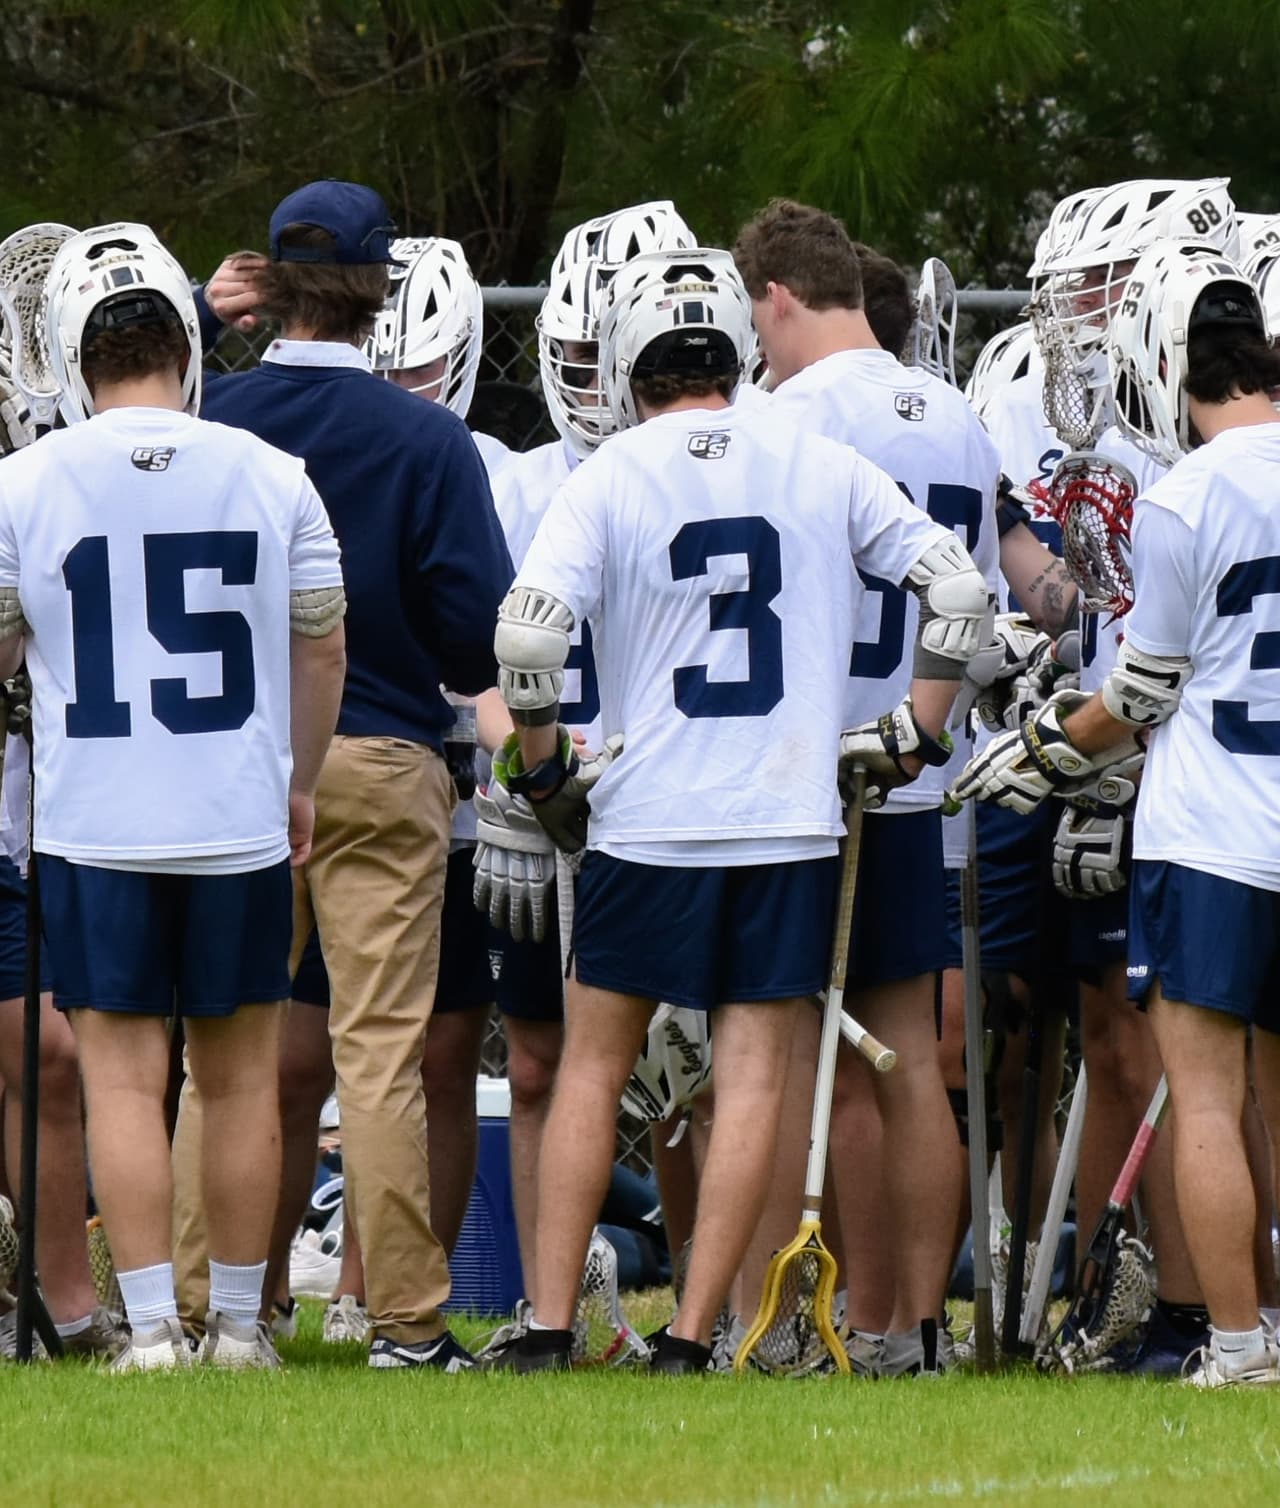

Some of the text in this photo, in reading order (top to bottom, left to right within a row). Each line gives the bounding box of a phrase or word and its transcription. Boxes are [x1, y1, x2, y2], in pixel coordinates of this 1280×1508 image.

[1185, 198, 1222, 236] 88
[1121, 281, 1146, 318] 33
[131, 446, 176, 471] GS
[62, 530, 259, 739] 15
[668, 516, 785, 719] 3
